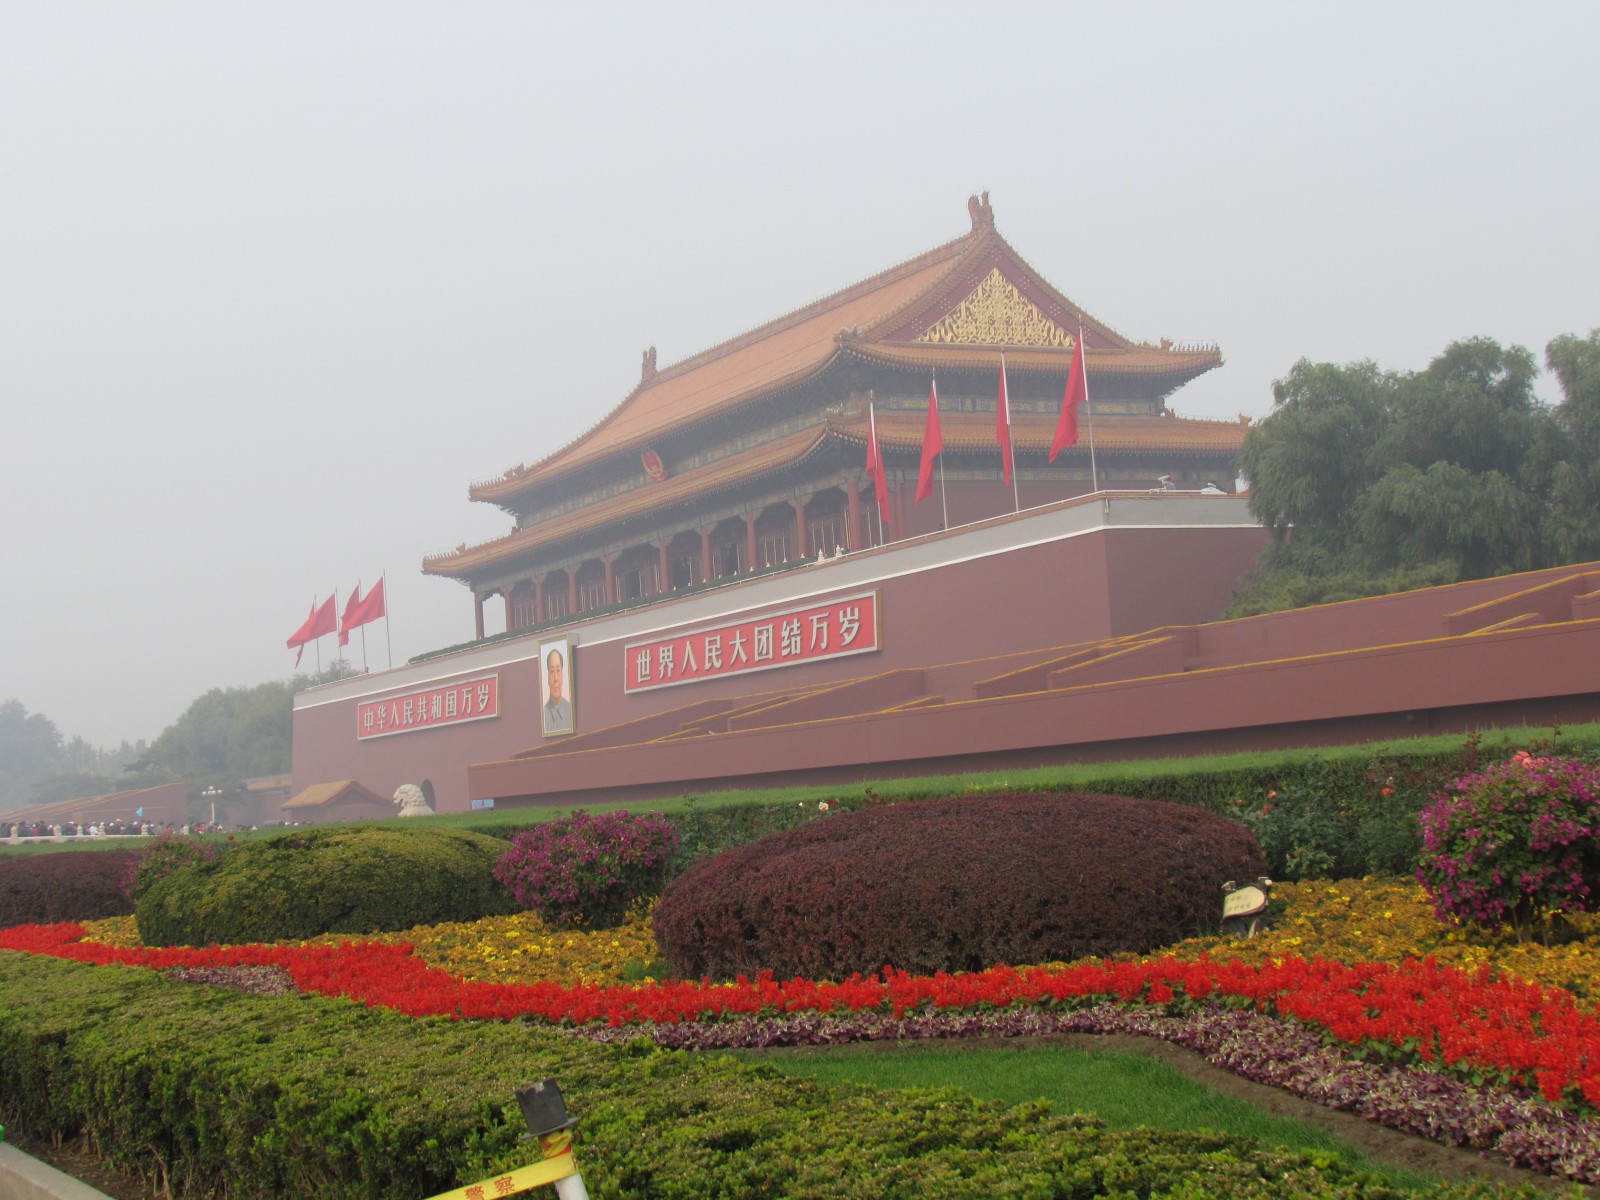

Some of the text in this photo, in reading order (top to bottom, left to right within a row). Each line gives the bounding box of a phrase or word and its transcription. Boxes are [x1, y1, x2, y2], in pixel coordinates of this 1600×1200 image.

[636, 606, 860, 684] 世界人民大团结万岁
[363, 683, 489, 732] 中华人民共和国万岁
